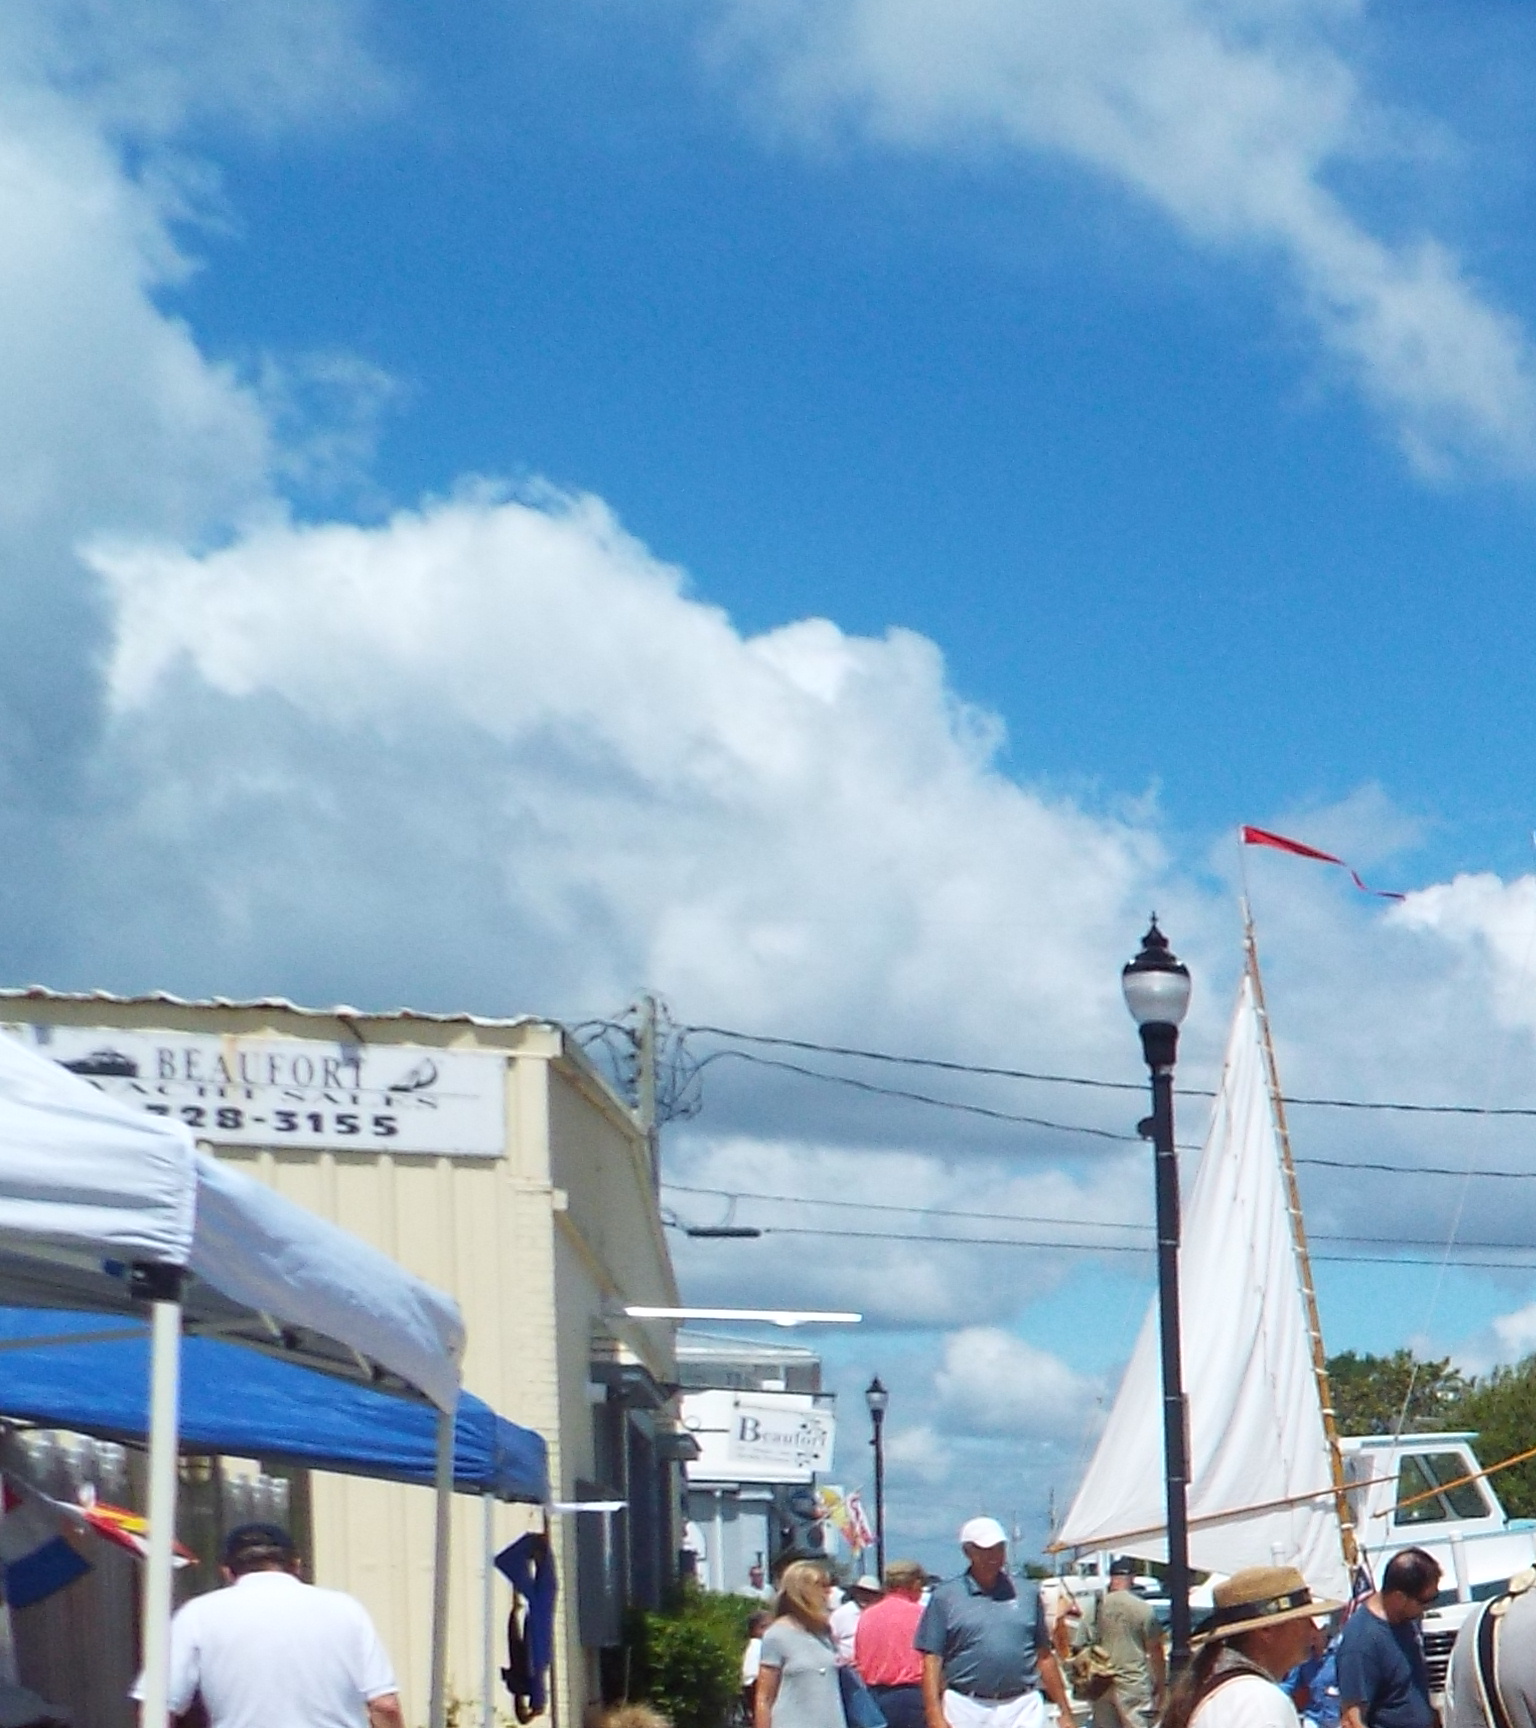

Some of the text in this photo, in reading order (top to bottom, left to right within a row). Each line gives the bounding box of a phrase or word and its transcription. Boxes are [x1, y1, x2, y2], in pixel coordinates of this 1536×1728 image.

[158, 1046, 363, 1090] BEAUFORT
[282, 1090, 439, 1110] SALES
[739, 1415, 827, 1447] Beaufort
